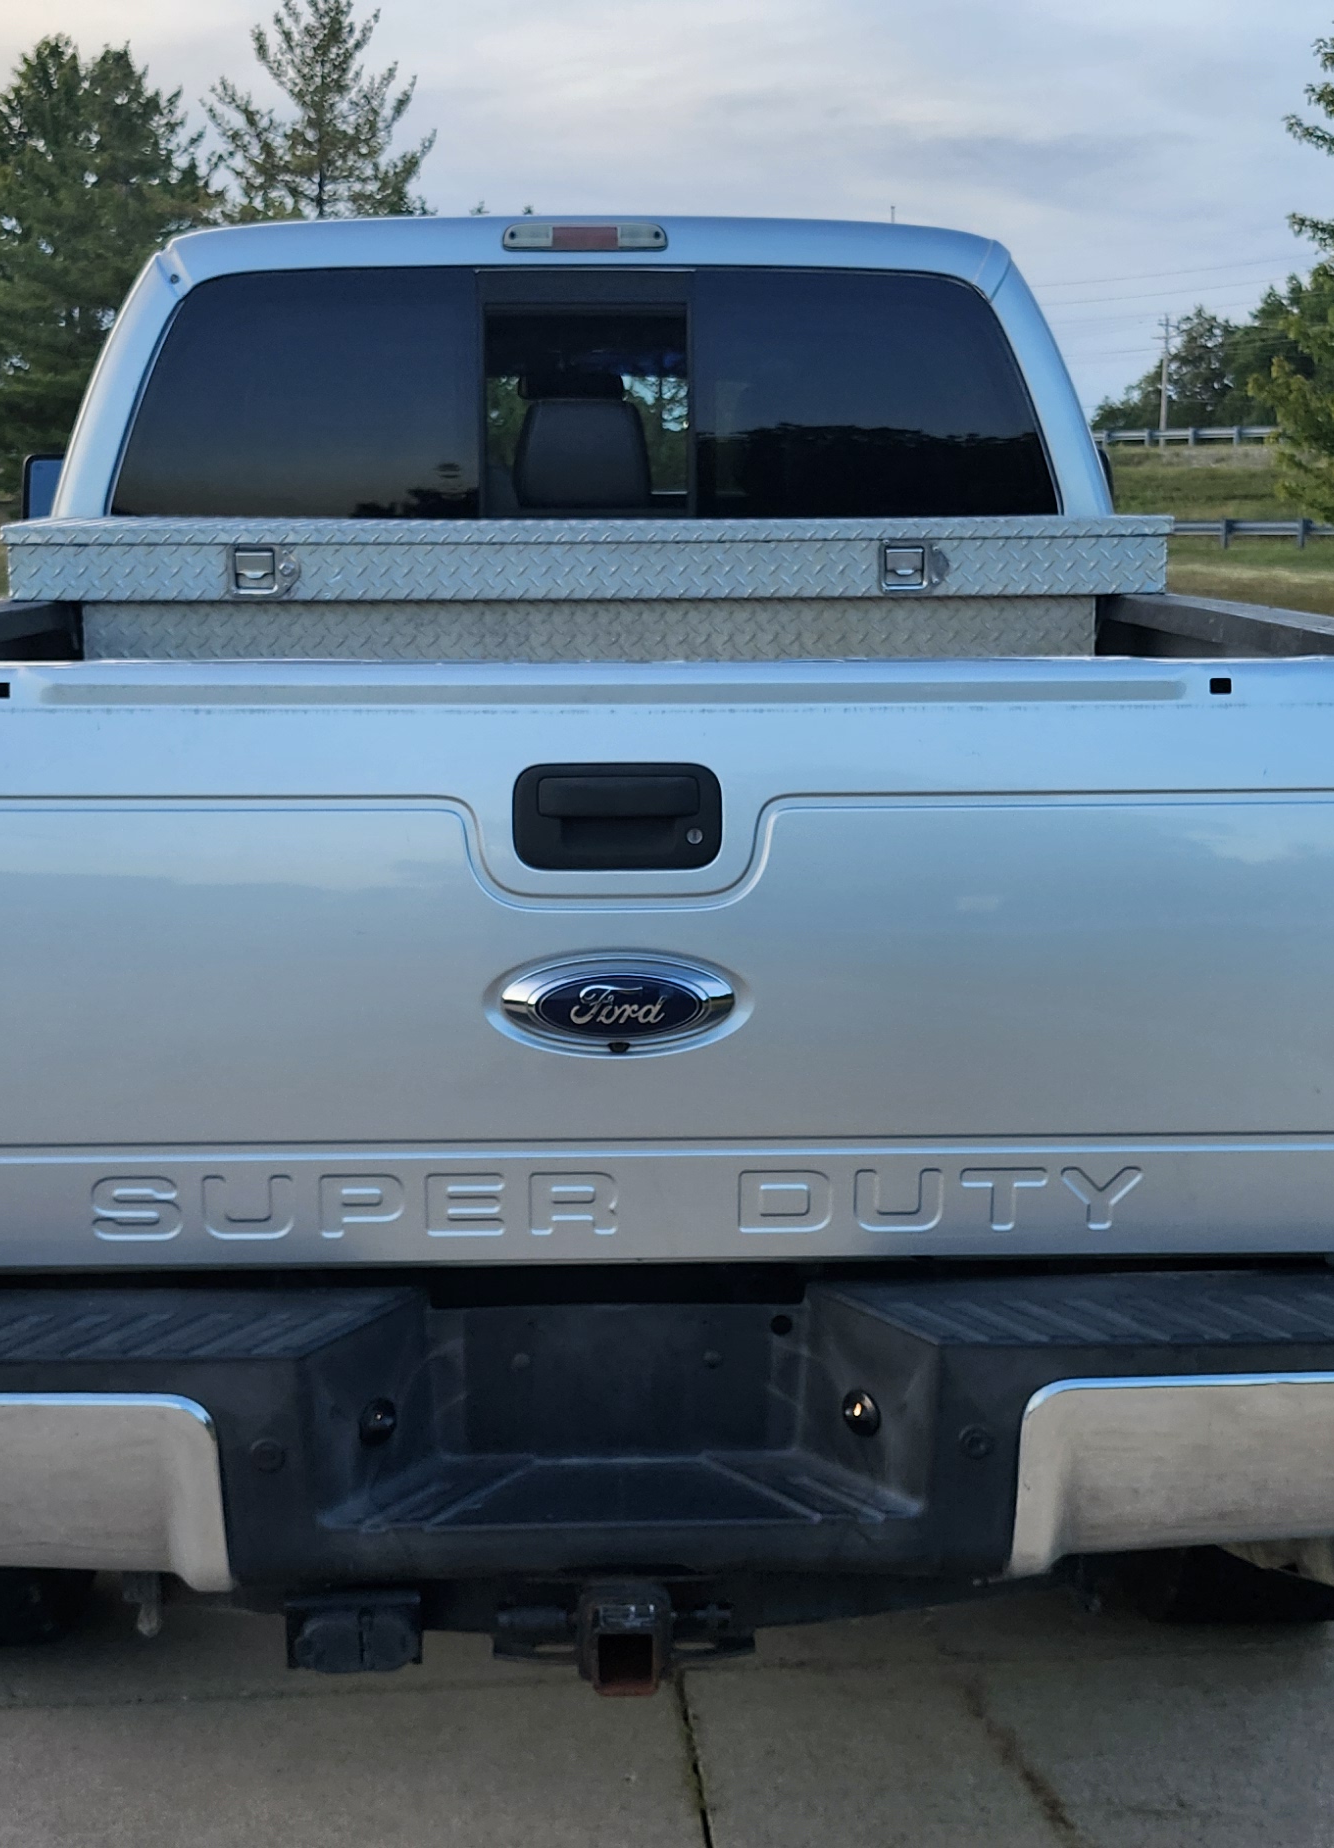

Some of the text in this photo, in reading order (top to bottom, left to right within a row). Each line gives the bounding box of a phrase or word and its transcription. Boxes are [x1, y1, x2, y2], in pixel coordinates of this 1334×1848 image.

[570, 984, 665, 1024] Ford
[91, 1165, 1144, 1241] SUPER DUTY
